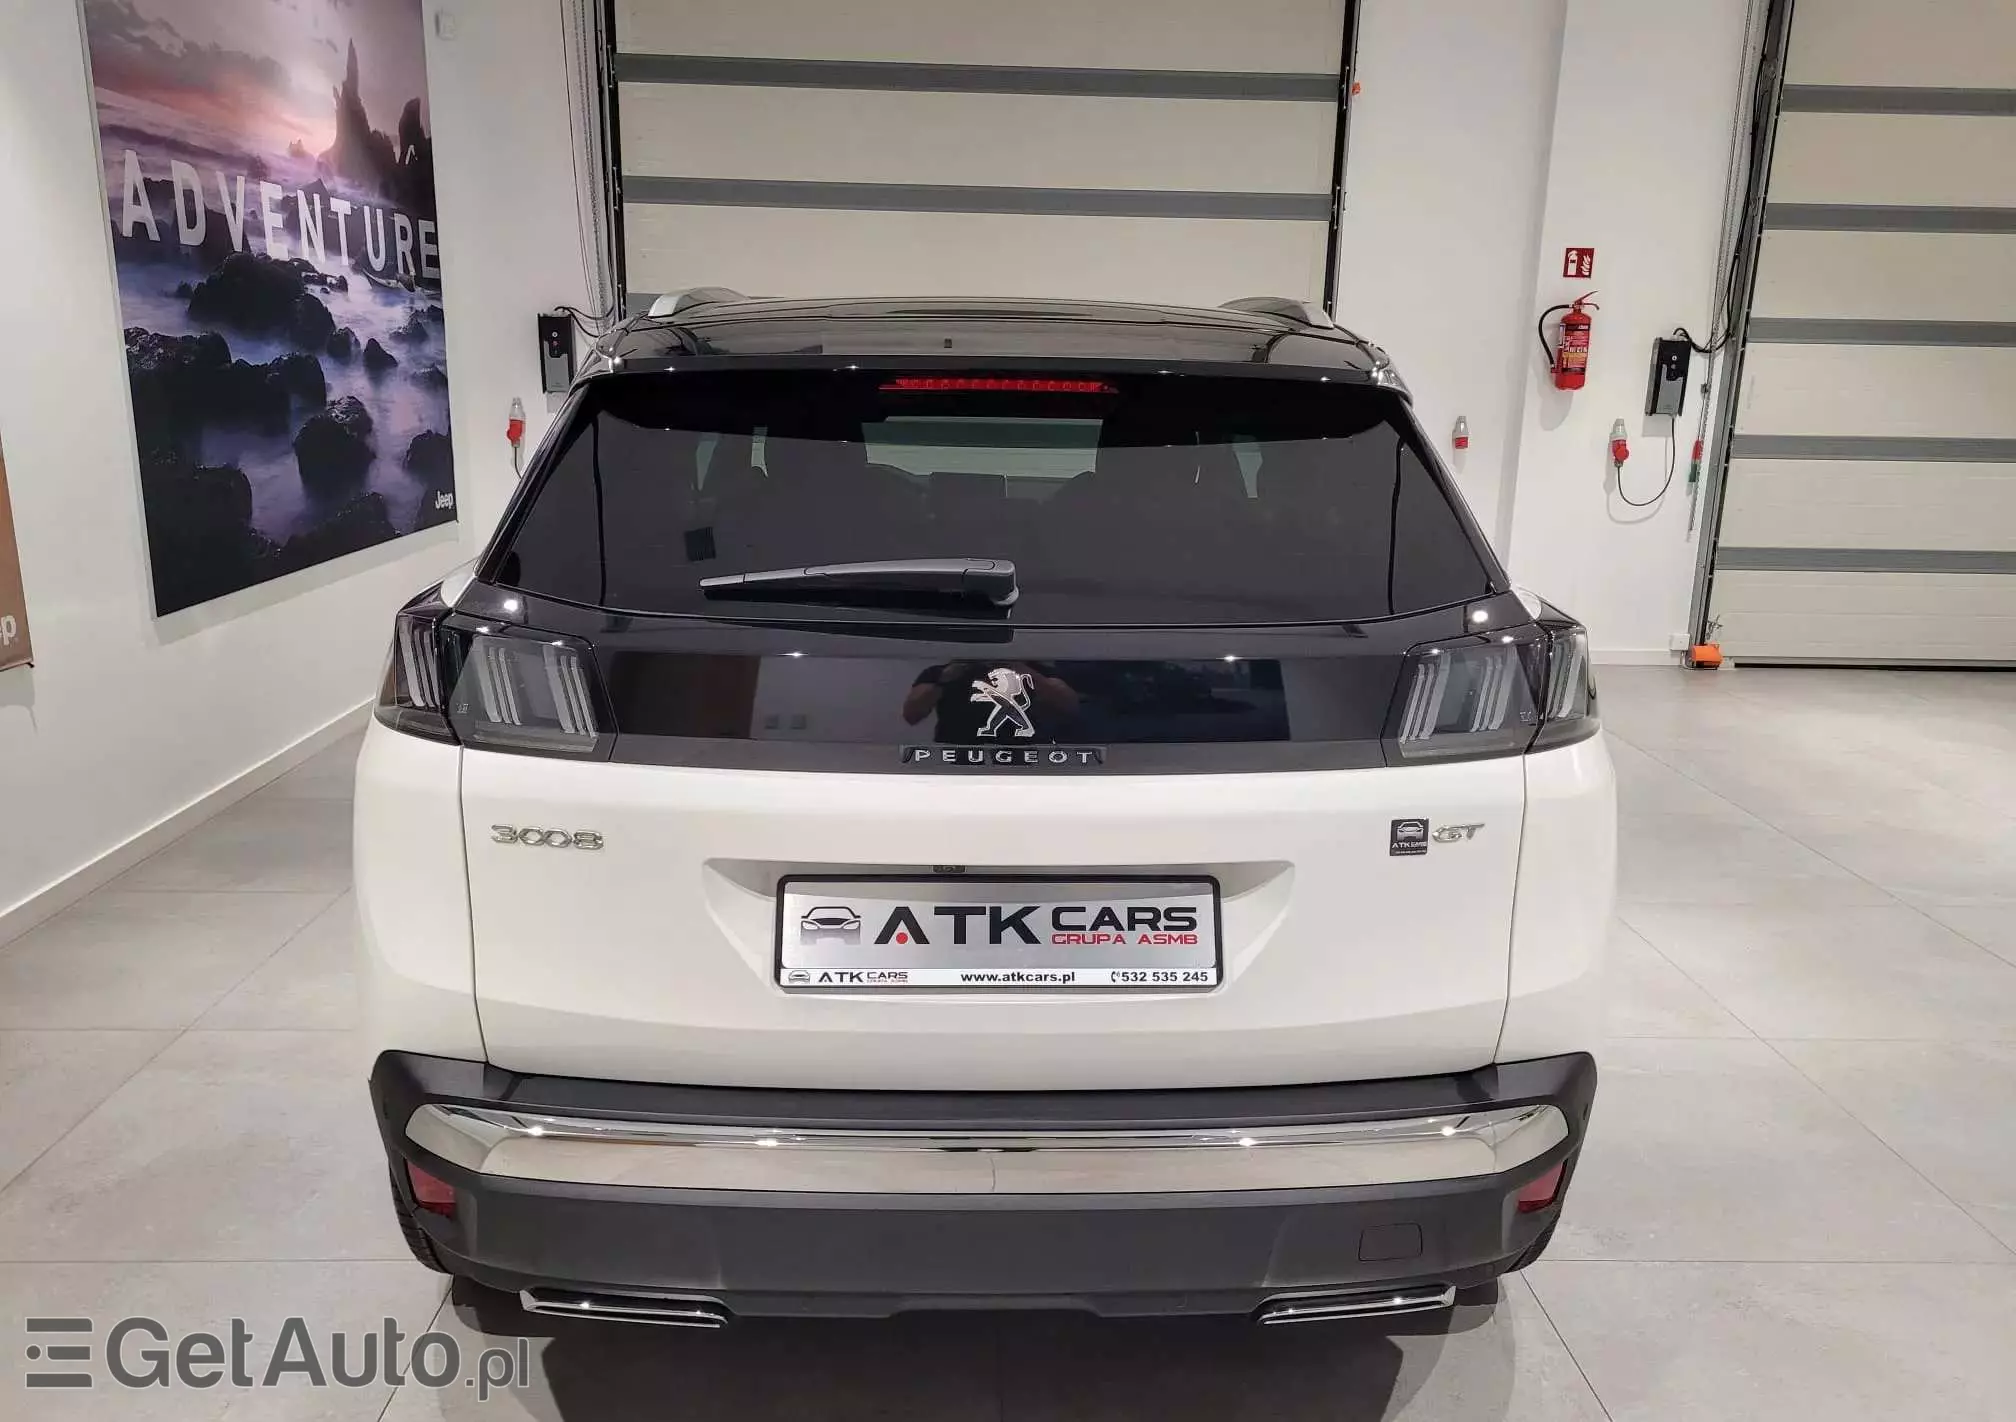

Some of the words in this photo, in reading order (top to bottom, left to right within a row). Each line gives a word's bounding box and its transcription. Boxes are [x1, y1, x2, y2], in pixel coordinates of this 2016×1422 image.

[121, 149, 440, 281] ADVENTURE
[435, 490, 454, 510] Jeep
[915, 749, 1093, 764] PEUGEOT
[491, 824, 604, 850] 3008
[1432, 823, 1485, 843] GT
[873, 905, 1042, 945] ATK
[1051, 906, 1198, 932] CARS
[1051, 933, 1127, 945] GRUPA
[1137, 933, 1198, 945] ASMB
[818, 971, 865, 983] ATK
[866, 971, 909, 980] CARS
[960, 971, 1076, 984] www.atkcars.pl
[1120, 971, 1148, 983] 532
[1151, 971, 1179, 983] 535
[1182, 971, 1209, 983] 245
